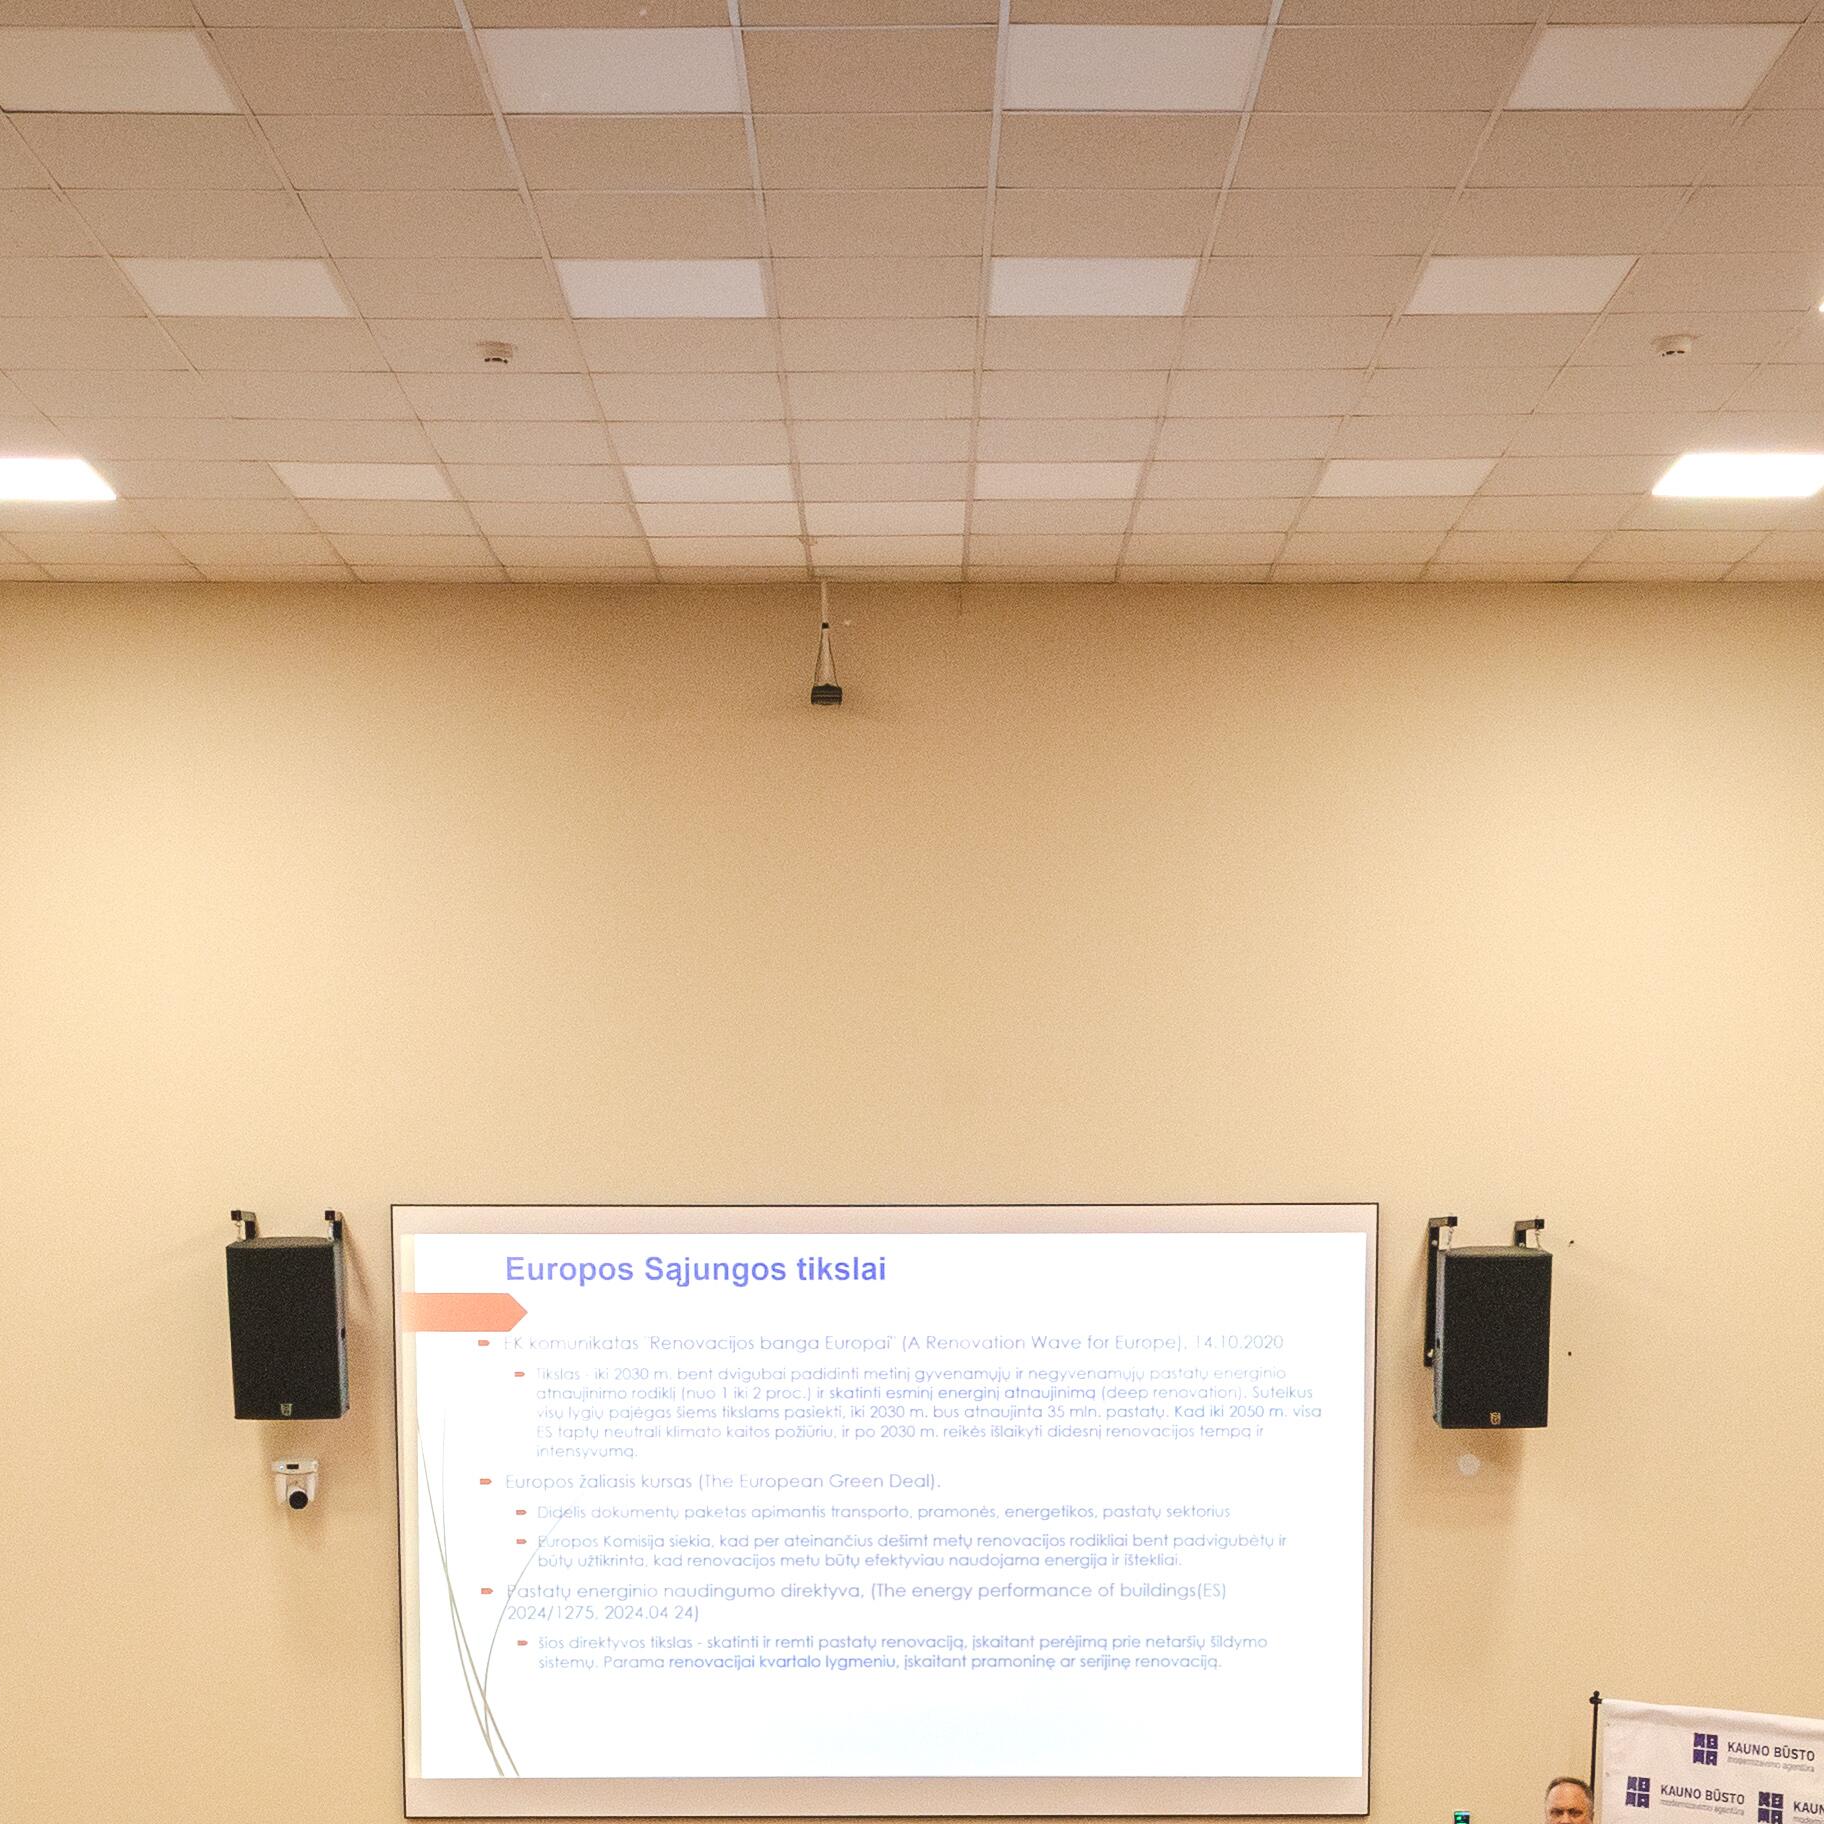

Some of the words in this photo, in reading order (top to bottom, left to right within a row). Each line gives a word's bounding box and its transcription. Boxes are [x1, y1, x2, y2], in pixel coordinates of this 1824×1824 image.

[506, 1256, 634, 1287] Europos
[645, 1256, 786, 1287] Sąjungos
[796, 1256, 886, 1281] tikslai
[760, 1335, 820, 1354] banga
[1030, 1335, 1083, 1351] Wave
[1087, 1334, 1109, 1350] for
[677, 1369, 713, 1381] bent
[733, 1387, 748, 1399] iki
[829, 1386, 881, 1400] skatinti
[722, 1405, 780, 1419] tikslams
[850, 1405, 865, 1418] iki
[869, 1405, 906, 1419] 2030
[933, 1405, 960, 1419] bus
[963, 1404, 1043, 1421] atnaujinta
[1174, 1405, 1206, 1418] Kad
[1209, 1404, 1225, 1417] iki
[1229, 1405, 1265, 1418] 2050
[1292, 1404, 1322, 1418] visa
[726, 1425, 770, 1438] kaitos
[880, 1424, 916, 1438] 2030
[641, 1474, 693, 1489] kursas
[739, 1474, 824, 1491] European
[828, 1473, 884, 1488] Green
[684, 1505, 747, 1520] paketas
[751, 1505, 826, 1521] apimantis
[1166, 1505, 1231, 1518] sektorius
[603, 1534, 665, 1551] Komisija
[719, 1534, 749, 1548] kad
[753, 1536, 780, 1550] per
[976, 1533, 1066, 1550] renovacijos
[1069, 1533, 1128, 1548] rodikliai
[1132, 1533, 1169, 1547] bent
[653, 1554, 683, 1567] kad
[687, 1553, 776, 1570] renovacijos
[779, 1554, 821, 1567] metu
[864, 1553, 945, 1569] efektyviau
[948, 1553, 1040, 1570] naudojama
[1043, 1552, 1108, 1570] energija
[576, 1583, 658, 1602] energinio
[663, 1583, 776, 1602] naudingumo
[911, 1585, 973, 1601] energy
[977, 1582, 1093, 1601] performance
[568, 1636, 646, 1649] direktyvos
[650, 1635, 694, 1649] tikslas
[707, 1635, 759, 1649] skatinti
[774, 1635, 814, 1649] remti
[1111, 1635, 1142, 1651] prie
[603, 1655, 665, 1669] Parama
[668, 1654, 756, 1671] renovacijai
[759, 1654, 822, 1669] kvartalo
[1727, 1742, 1768, 1757] KAUNO
[1774, 1745, 1815, 1761] BŪSTO
[1661, 1785, 1701, 1799] KAUNO
[1705, 1790, 1745, 1805] BŪSTO
